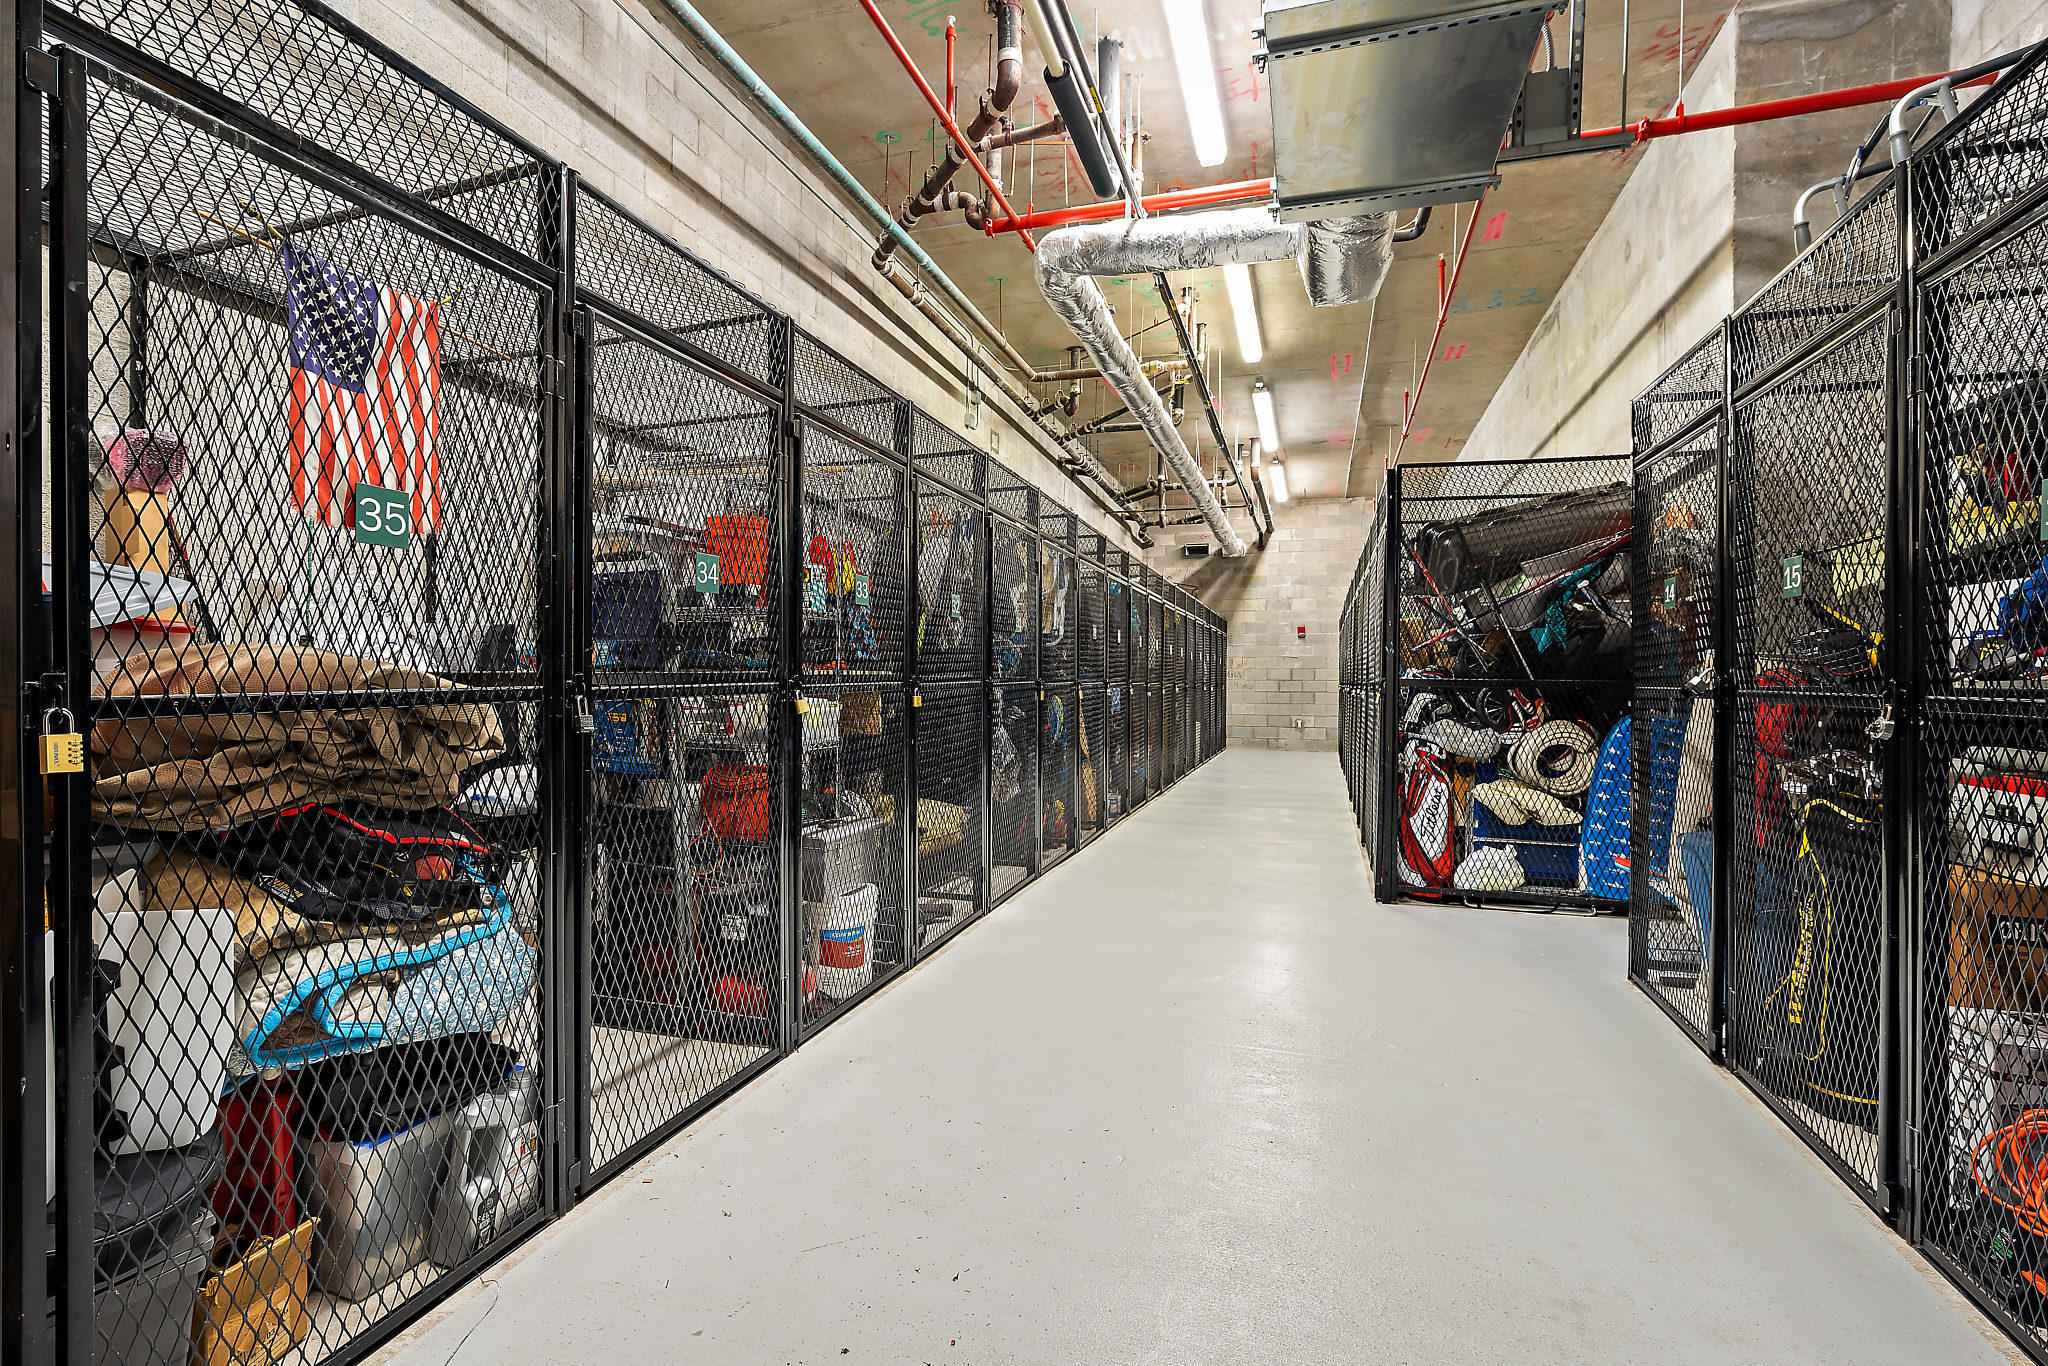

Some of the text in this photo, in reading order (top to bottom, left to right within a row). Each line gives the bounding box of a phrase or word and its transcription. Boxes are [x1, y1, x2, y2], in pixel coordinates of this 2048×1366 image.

[358, 497, 407, 536] 35
[697, 561, 718, 585] 34
[1784, 565, 1801, 589] 15
[856, 581, 868, 599] 33
[1664, 584, 1675, 602] 14
